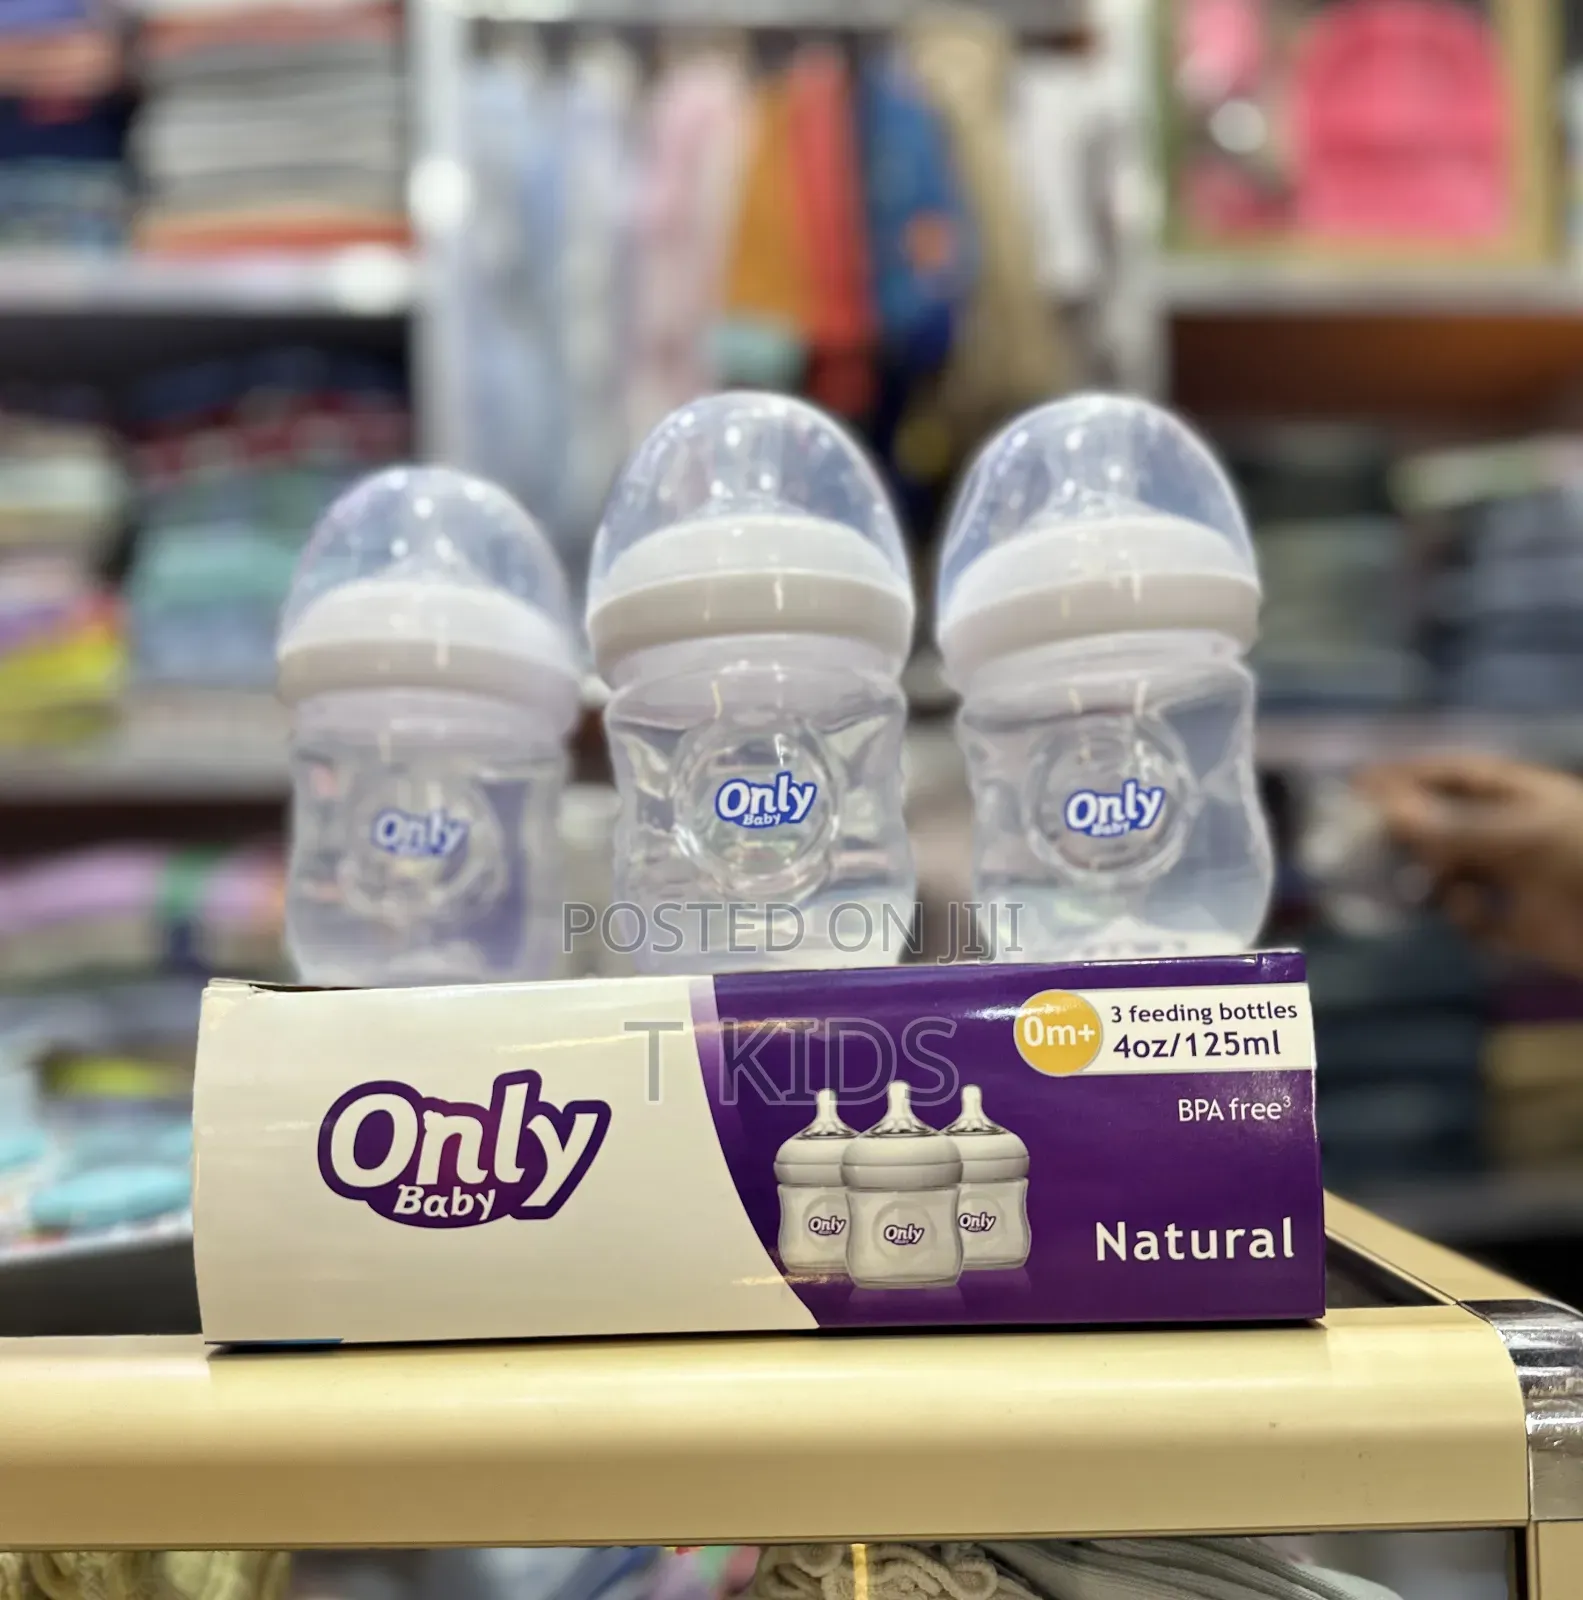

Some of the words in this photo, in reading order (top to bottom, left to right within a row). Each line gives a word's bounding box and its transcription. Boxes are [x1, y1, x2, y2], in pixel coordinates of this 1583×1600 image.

[717, 774, 815, 821] Only
[1066, 781, 1163, 828] Only
[374, 809, 465, 854] Only
[742, 813, 782, 827] Baby
[1110, 1005, 1123, 1023] 3
[1128, 1004, 1214, 1025] feeding
[1218, 1001, 1299, 1021] bottles
[1022, 1015, 1096, 1048] 0m+
[1112, 1029, 1282, 1059] 4oz/125ml
[1177, 1098, 1225, 1122] BPA
[328, 1079, 602, 1209] Only
[392, 1182, 497, 1221] Baby
[809, 1216, 846, 1235] Only
[884, 1224, 924, 1245] Only
[958, 1212, 996, 1232] Only
[1094, 1215, 1297, 1264] Natural
